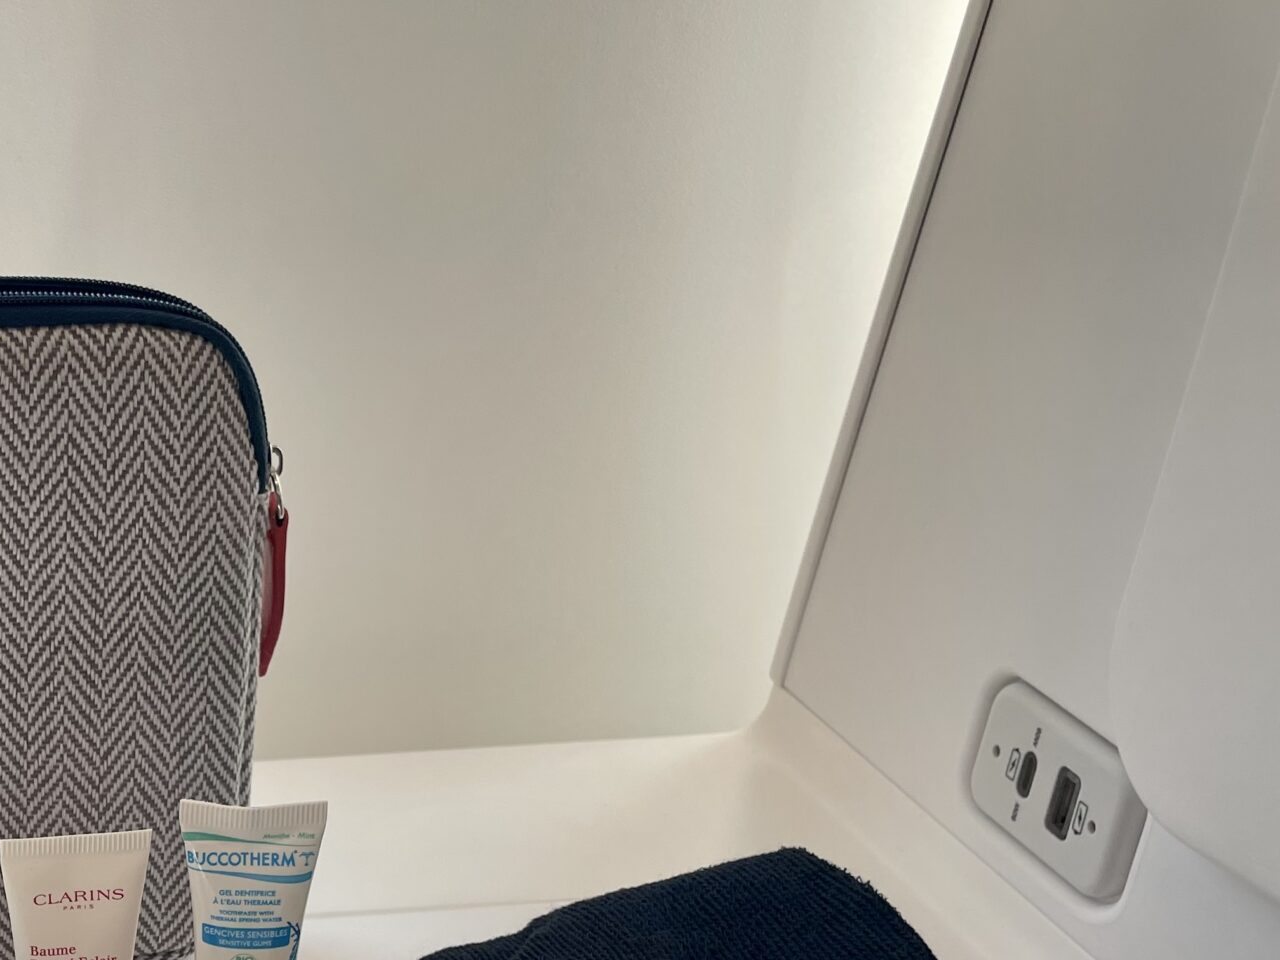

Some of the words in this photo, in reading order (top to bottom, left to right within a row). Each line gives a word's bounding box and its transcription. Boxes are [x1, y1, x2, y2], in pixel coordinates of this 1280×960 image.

[33, 888, 125, 906] CLARINS
[204, 926, 245, 939] GENCIVES
[247, 928, 288, 939] SENSIBLES
[219, 939, 250, 947] SENSITIVE
[252, 939, 272, 947] GUMS
[30, 945, 77, 957] Baume
